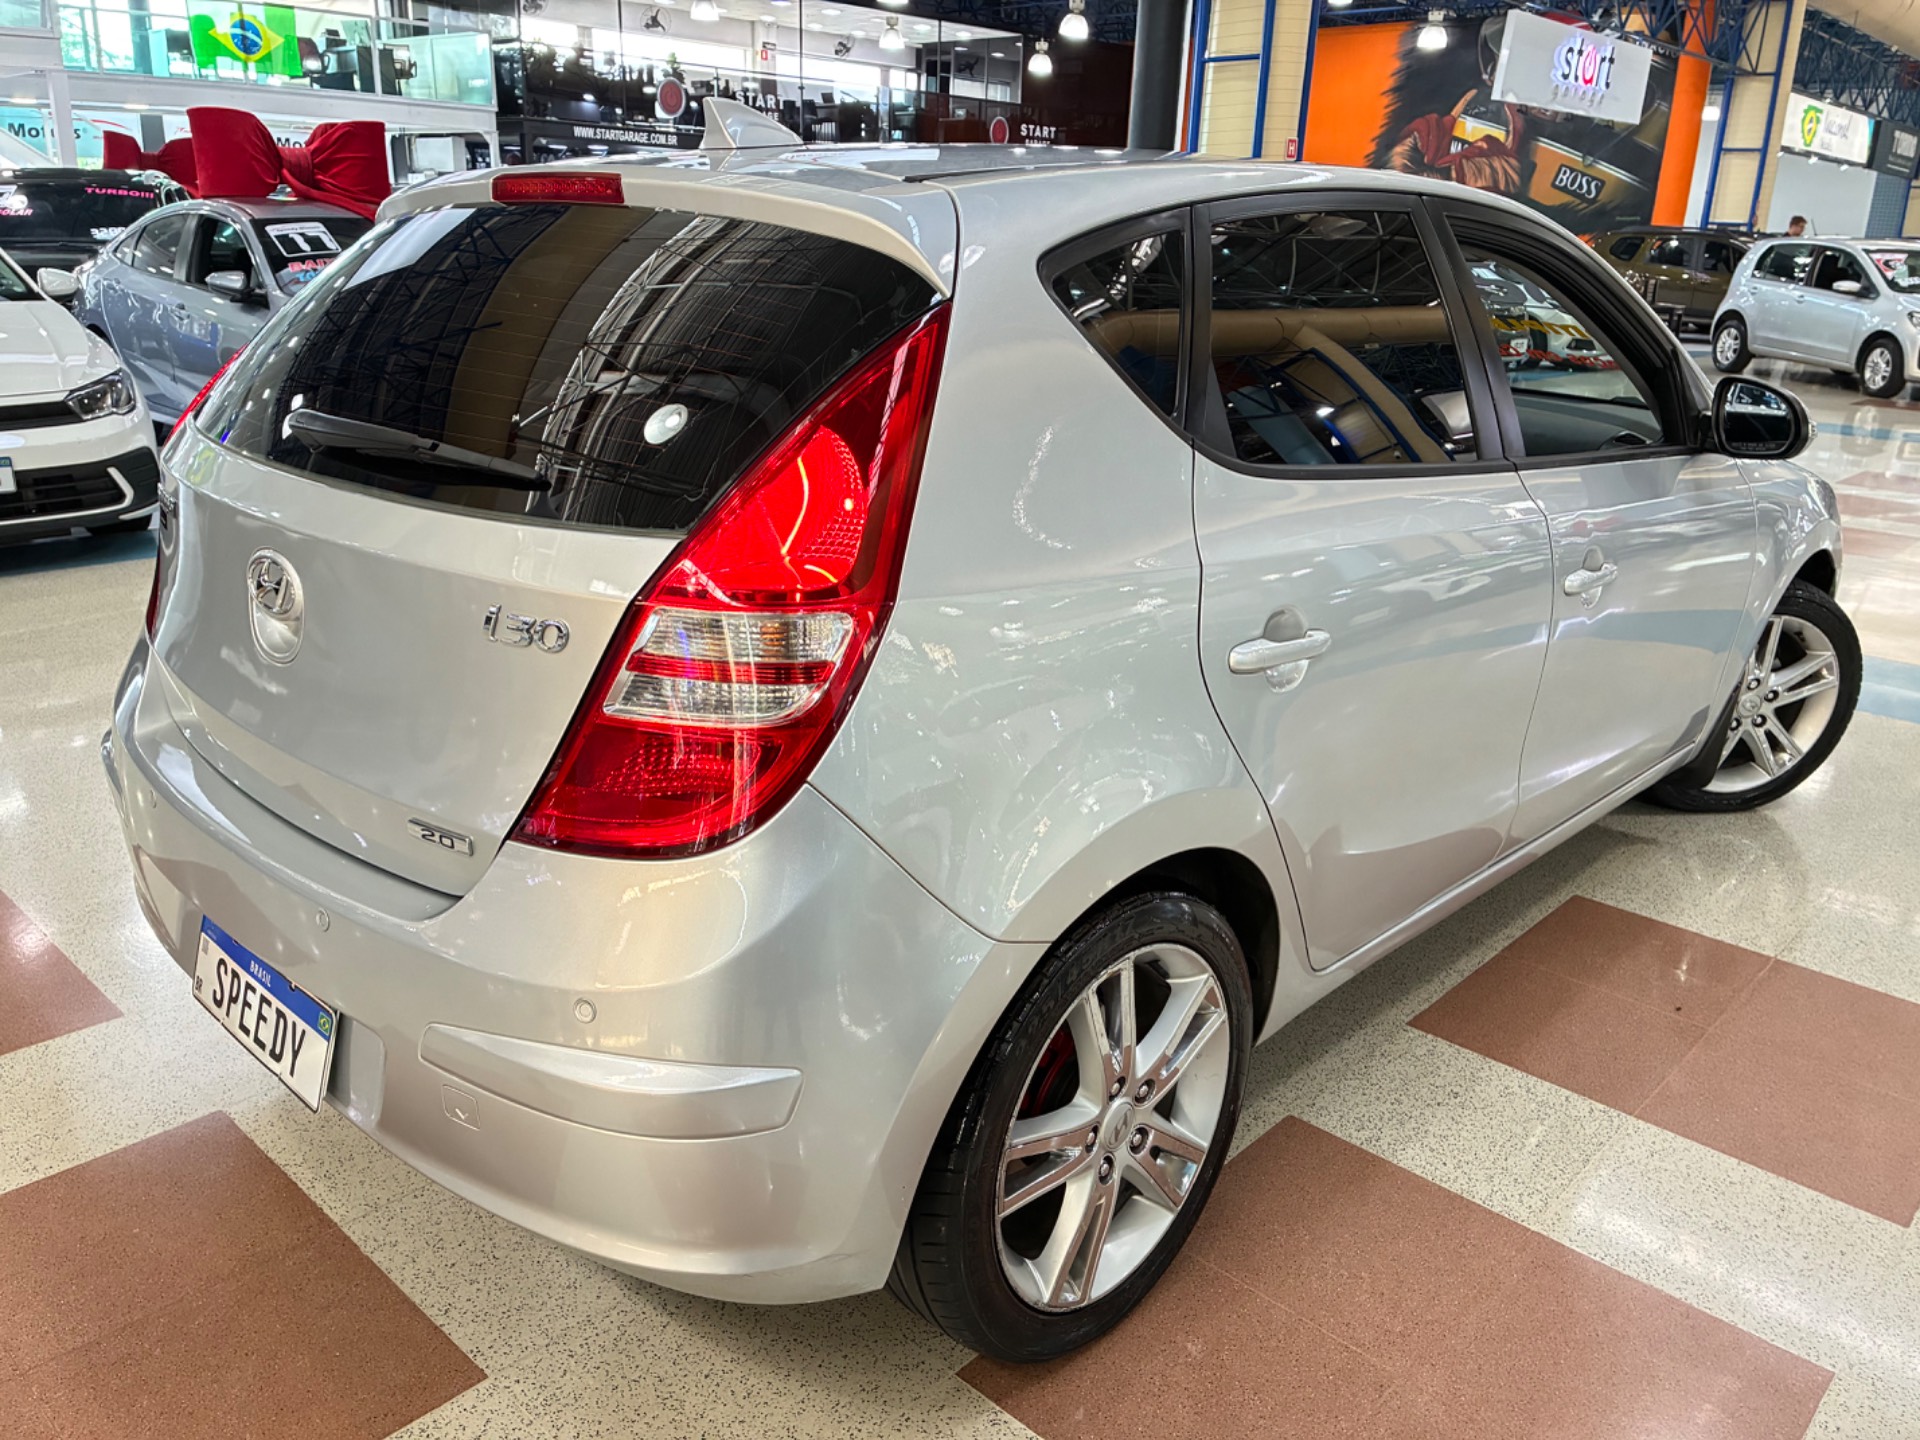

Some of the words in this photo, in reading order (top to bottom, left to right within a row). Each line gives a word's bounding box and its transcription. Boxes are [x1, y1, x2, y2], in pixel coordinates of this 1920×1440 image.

[735, 90, 785, 109] START
[573, 126, 678, 146] WWW.STARTGARAGE.COM.BR
[1020, 123, 1057, 139] START
[1555, 166, 1602, 199] BOSS
[289, 231, 337, 252] 17
[249, 960, 271, 987] BRASIL
[212, 957, 306, 1078] SPEEDY
